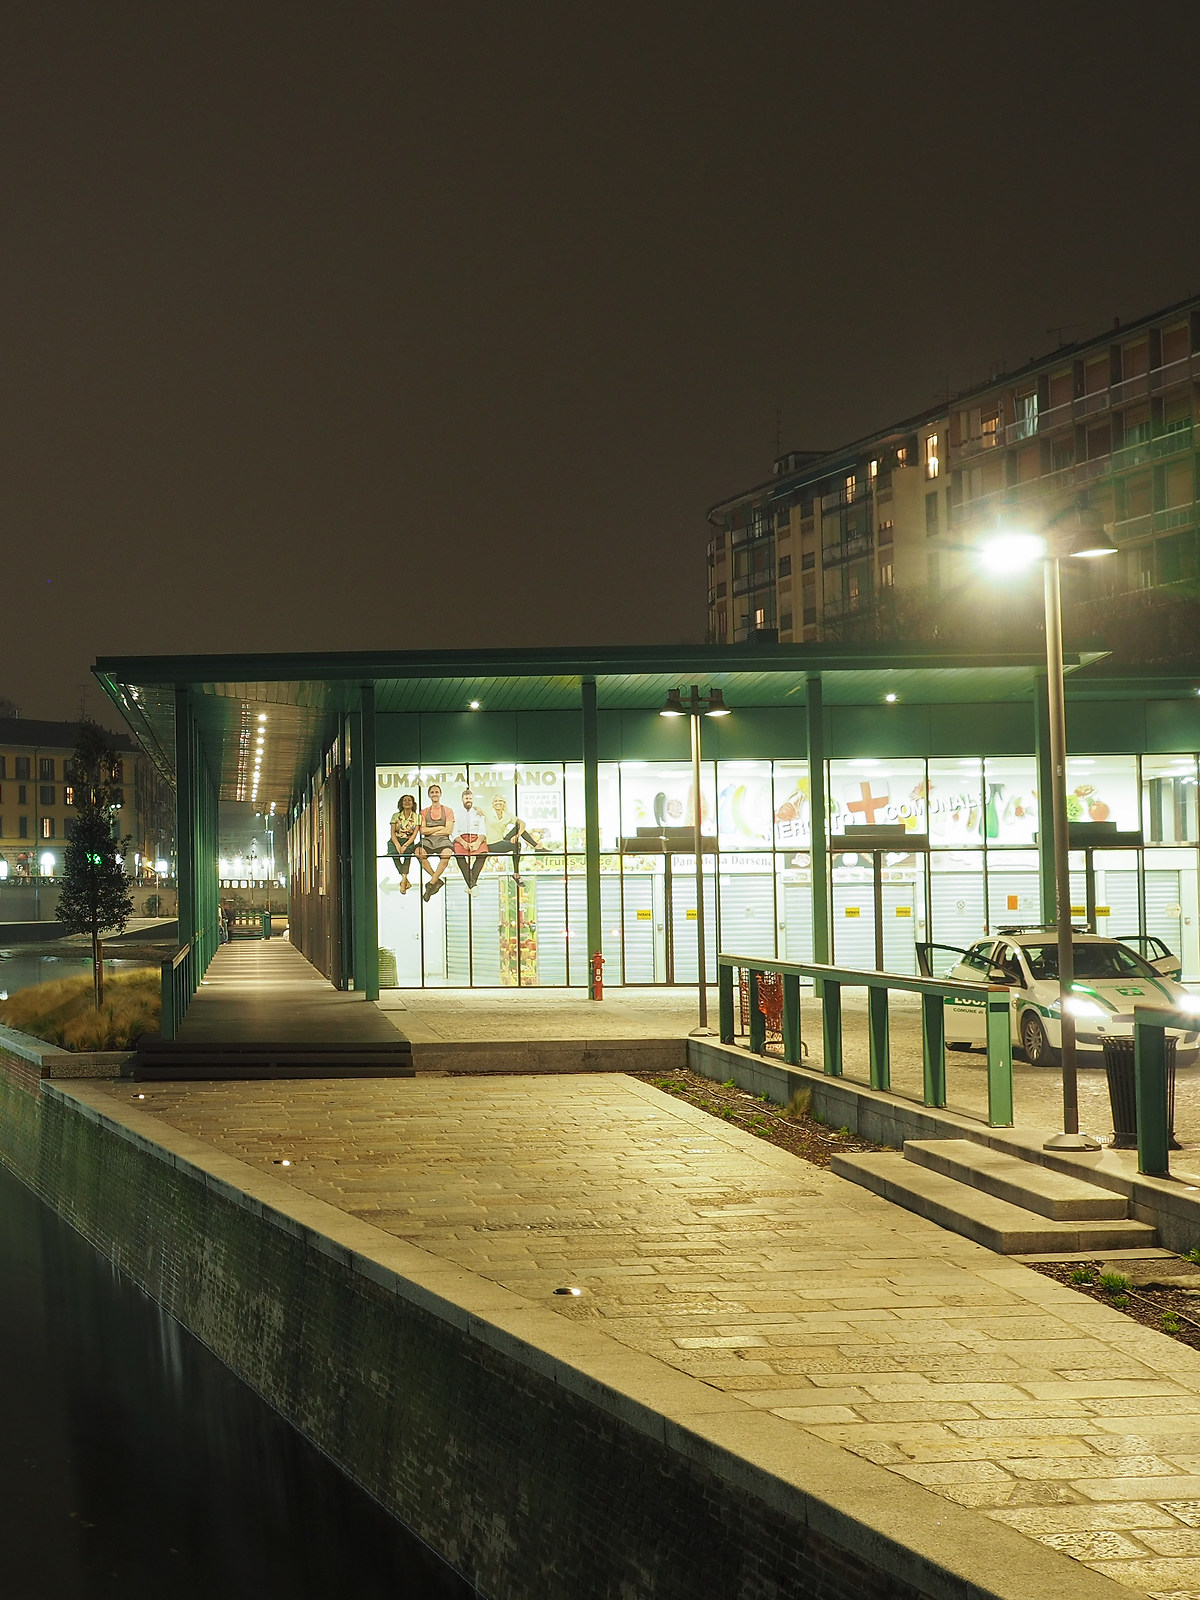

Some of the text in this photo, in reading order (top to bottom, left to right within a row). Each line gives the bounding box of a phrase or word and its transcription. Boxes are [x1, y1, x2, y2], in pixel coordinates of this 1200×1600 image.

[474, 771, 557, 788] MILANO
[765, 812, 856, 841] MERTO
[580, 857, 612, 866] Jce
